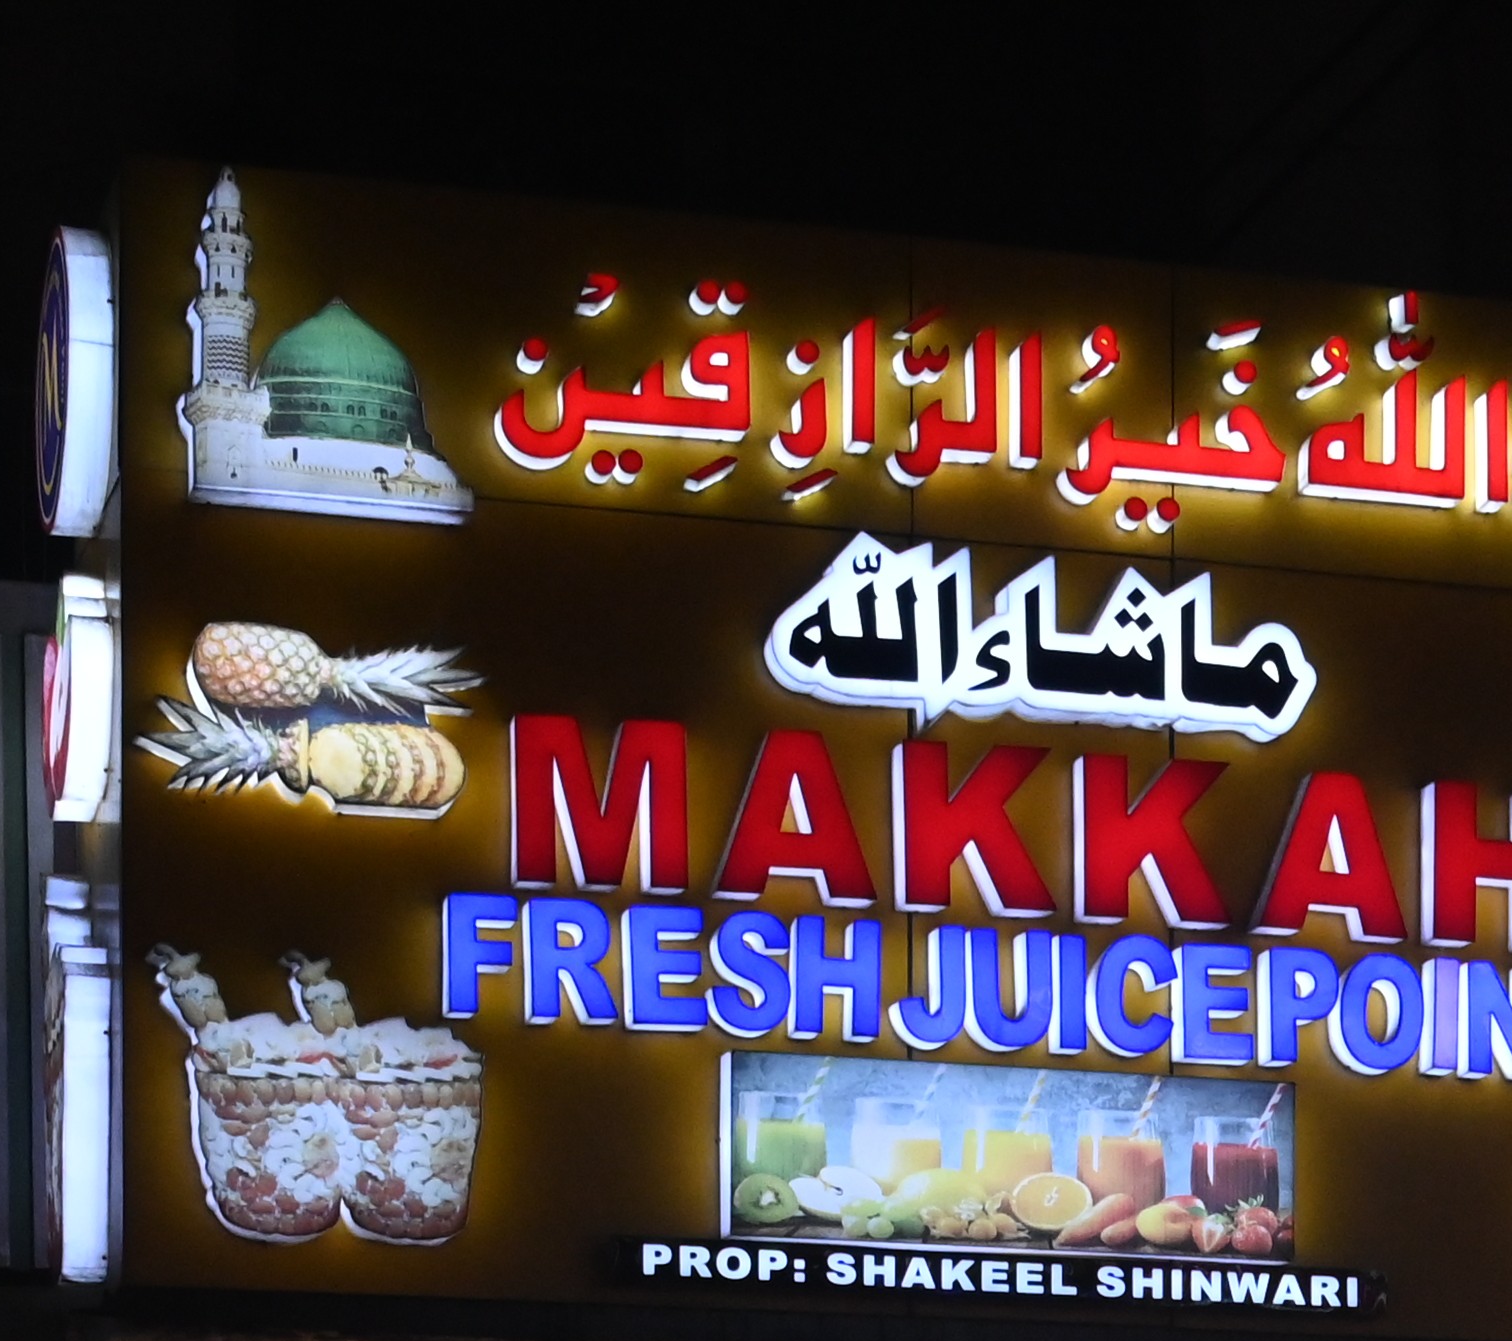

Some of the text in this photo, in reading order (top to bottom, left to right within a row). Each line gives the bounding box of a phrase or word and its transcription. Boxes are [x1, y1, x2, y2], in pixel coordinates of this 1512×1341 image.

[641, 1241, 1361, 1308] PROP: SHAKEEL SHINWARI
